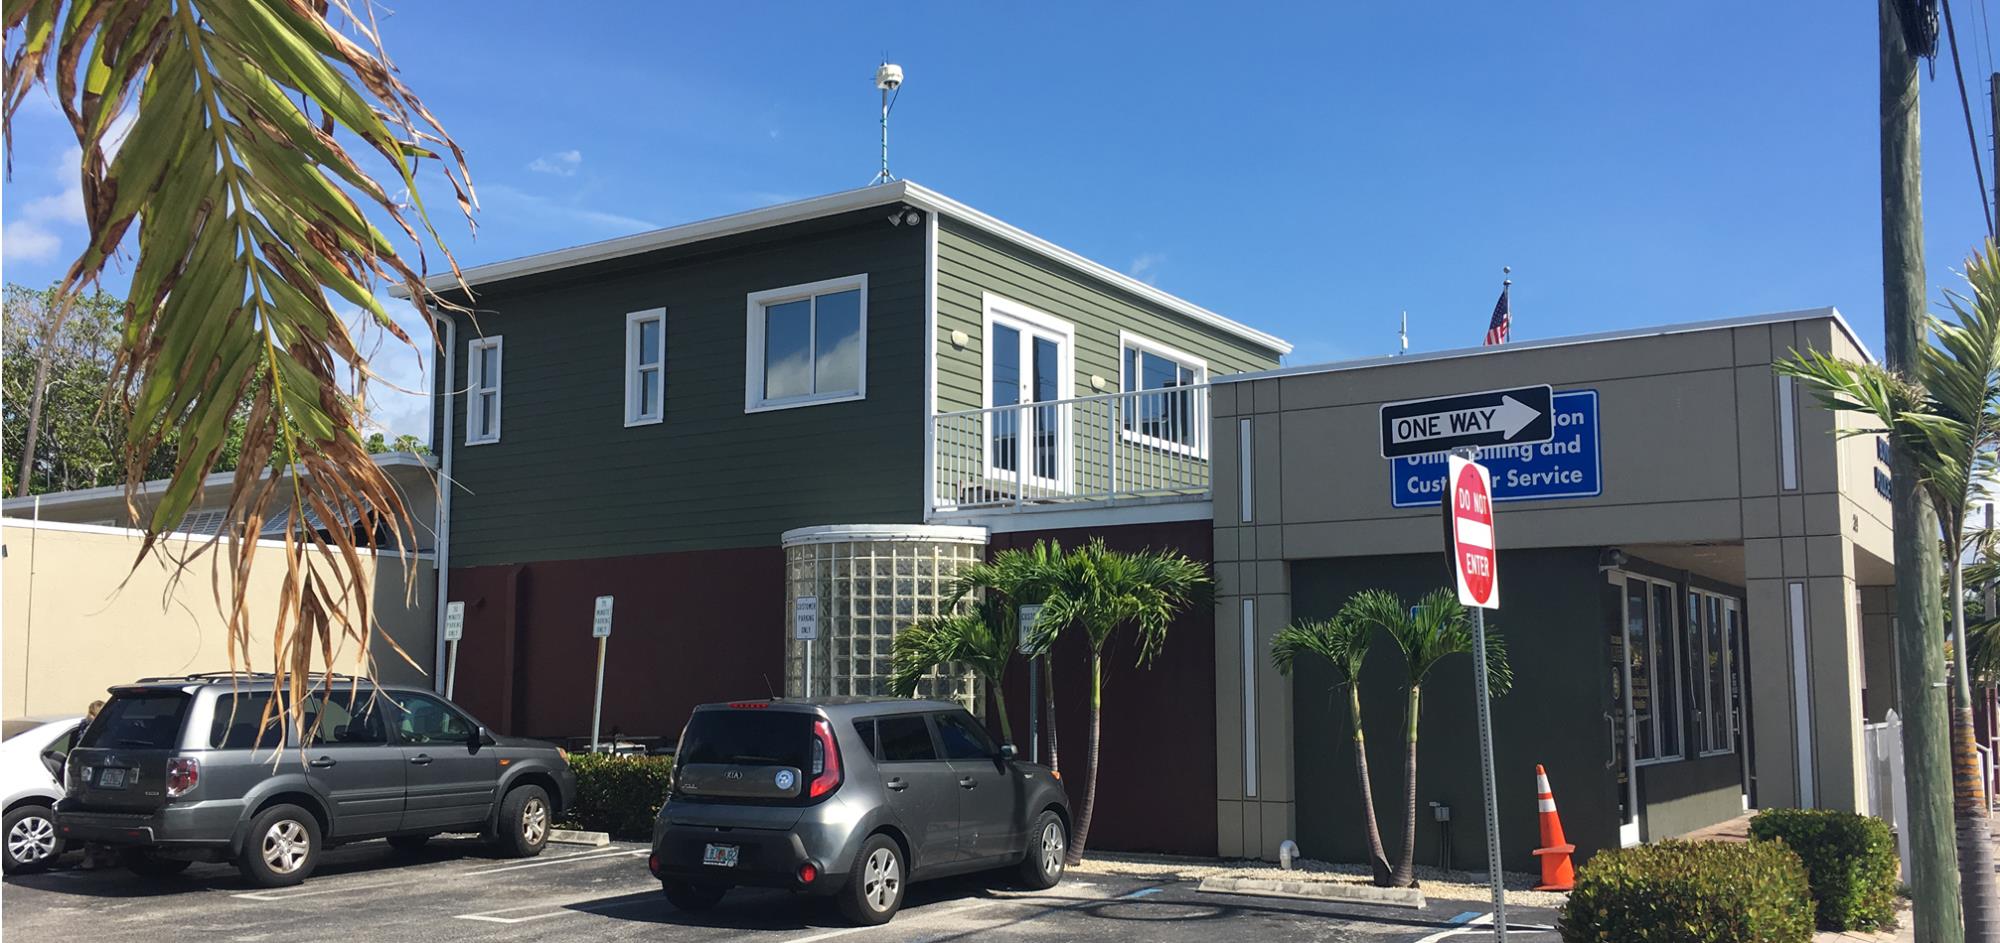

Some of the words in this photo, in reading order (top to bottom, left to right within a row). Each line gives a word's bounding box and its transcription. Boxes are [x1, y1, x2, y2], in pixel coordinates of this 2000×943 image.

[1398, 416, 1441, 440] ONE
[1449, 408, 1496, 433] WAY
[1540, 434, 1581, 456] and
[1407, 475, 1501, 494] Custr
[1507, 465, 1583, 488] Service
[1459, 487, 1471, 511] DO
[1473, 491, 1488, 515] NOT
[1466, 552, 1490, 577] ENTER
[797, 602, 816, 610] CUSTOMER
[798, 614, 815, 622] PARKING
[801, 626, 811, 634] ONLY
